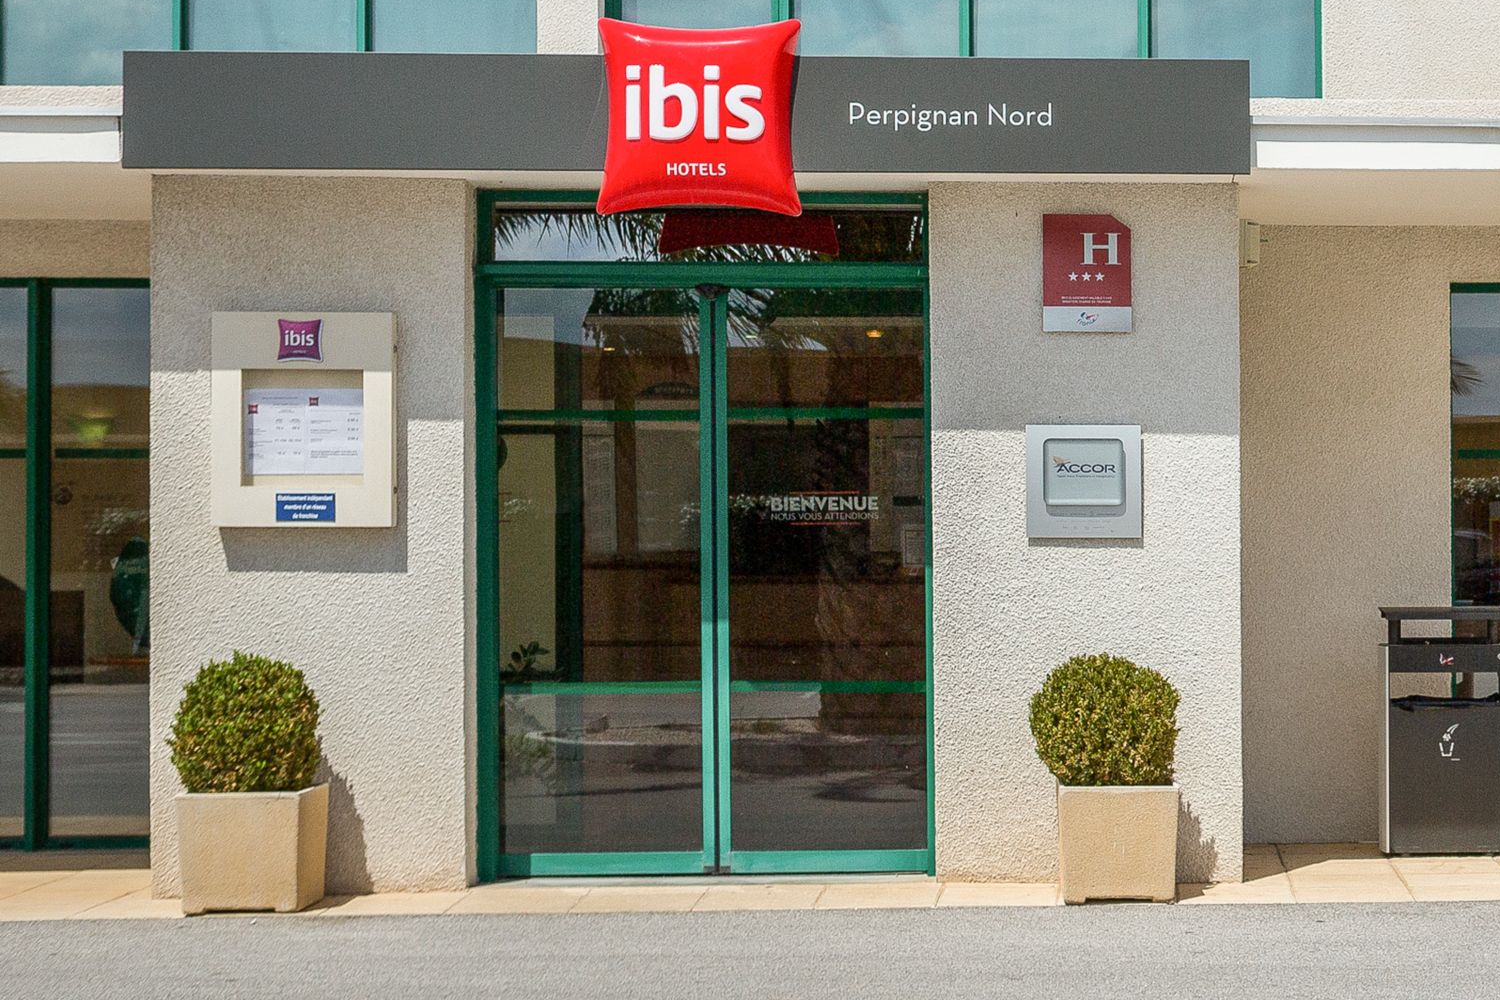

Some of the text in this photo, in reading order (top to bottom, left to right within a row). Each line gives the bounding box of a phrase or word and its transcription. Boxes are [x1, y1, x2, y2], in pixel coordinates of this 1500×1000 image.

[625, 63, 766, 142] ibis
[848, 102, 1053, 131] Perpignan Nord
[666, 161, 727, 176] HOTELS
[1079, 232, 1122, 265] H
[284, 330, 315, 346] ibis
[1056, 463, 1116, 473] ACCOR
[770, 496, 879, 511] BIENVENUE
[770, 511, 879, 521] NOUS VOUS ATTENDIONS
